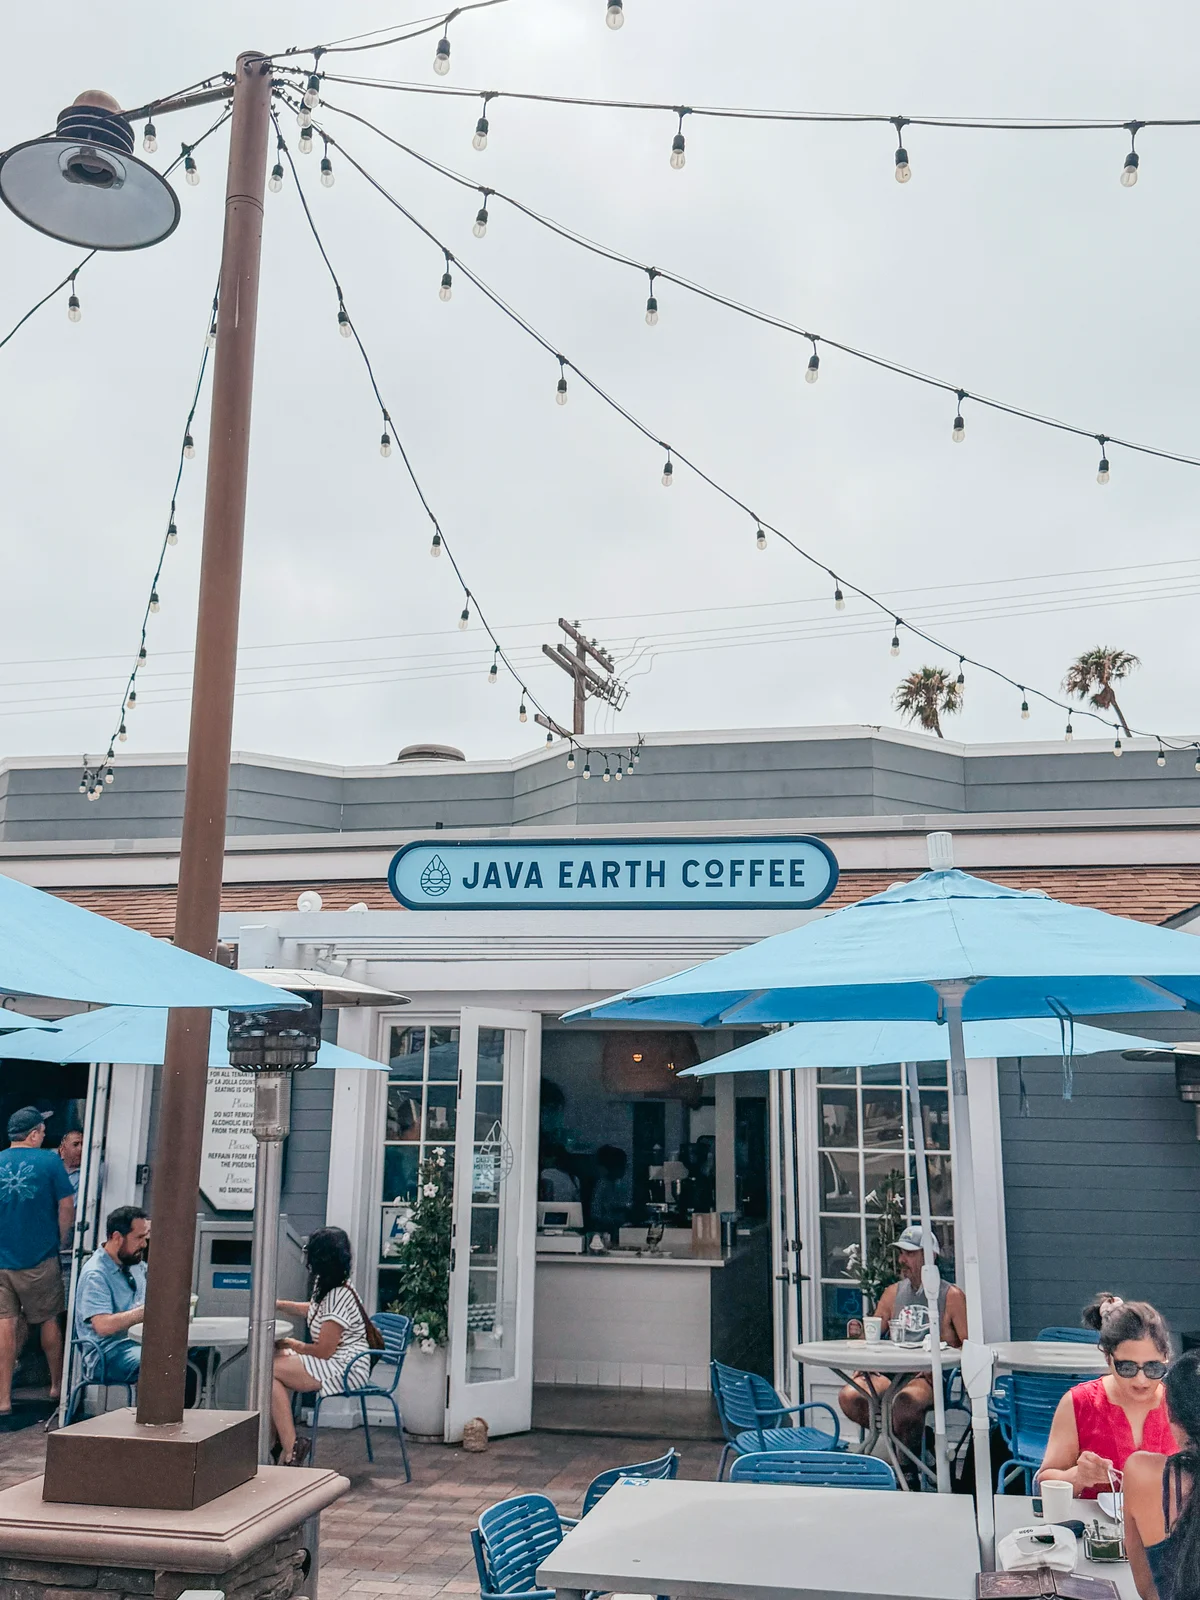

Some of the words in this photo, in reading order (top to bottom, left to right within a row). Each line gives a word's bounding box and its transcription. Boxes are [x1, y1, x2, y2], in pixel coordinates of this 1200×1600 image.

[462, 861, 544, 889] JAVA
[559, 860, 666, 889] EARTH
[682, 859, 806, 888] COFFEE
